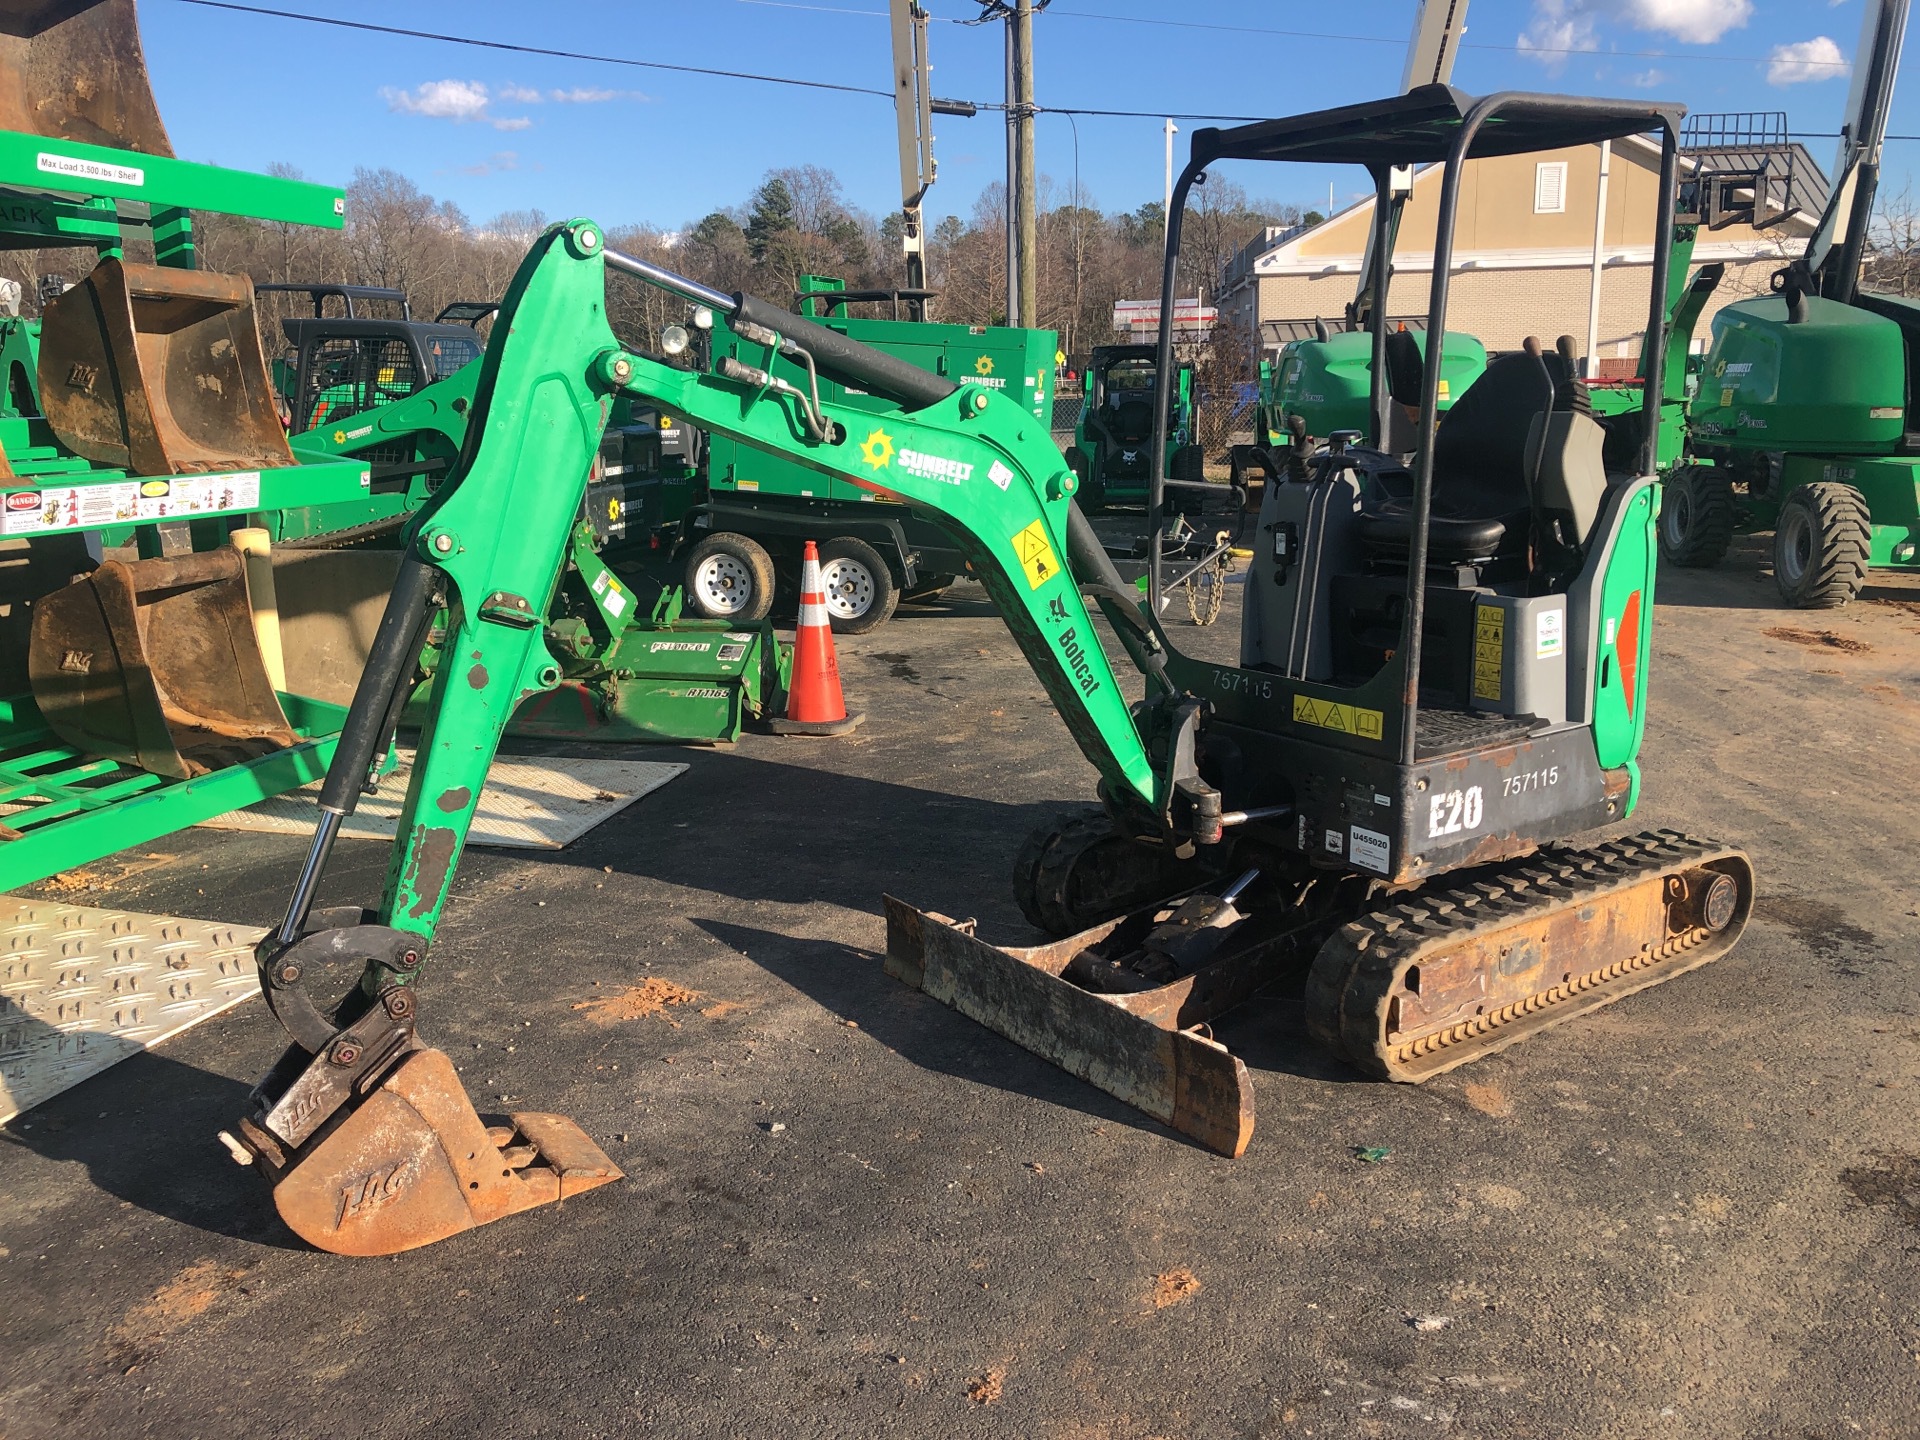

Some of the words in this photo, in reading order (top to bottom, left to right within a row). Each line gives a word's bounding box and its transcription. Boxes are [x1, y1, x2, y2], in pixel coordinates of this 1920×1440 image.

[41, 157, 57, 169] Max
[59, 161, 78, 172] Load
[118, 170, 137, 181] Shelf
[960, 376, 1006, 389] SUNBELT
[898, 448, 975, 481] SUNBELT
[906, 467, 962, 486] RENTALS
[9, 496, 40, 507] DANGER
[1058, 627, 1101, 698] Bobcat
[1212, 669, 1273, 699] 757115
[1502, 765, 1559, 797] 757115
[1428, 785, 1484, 838] E20
[1352, 831, 1388, 849] U455020
